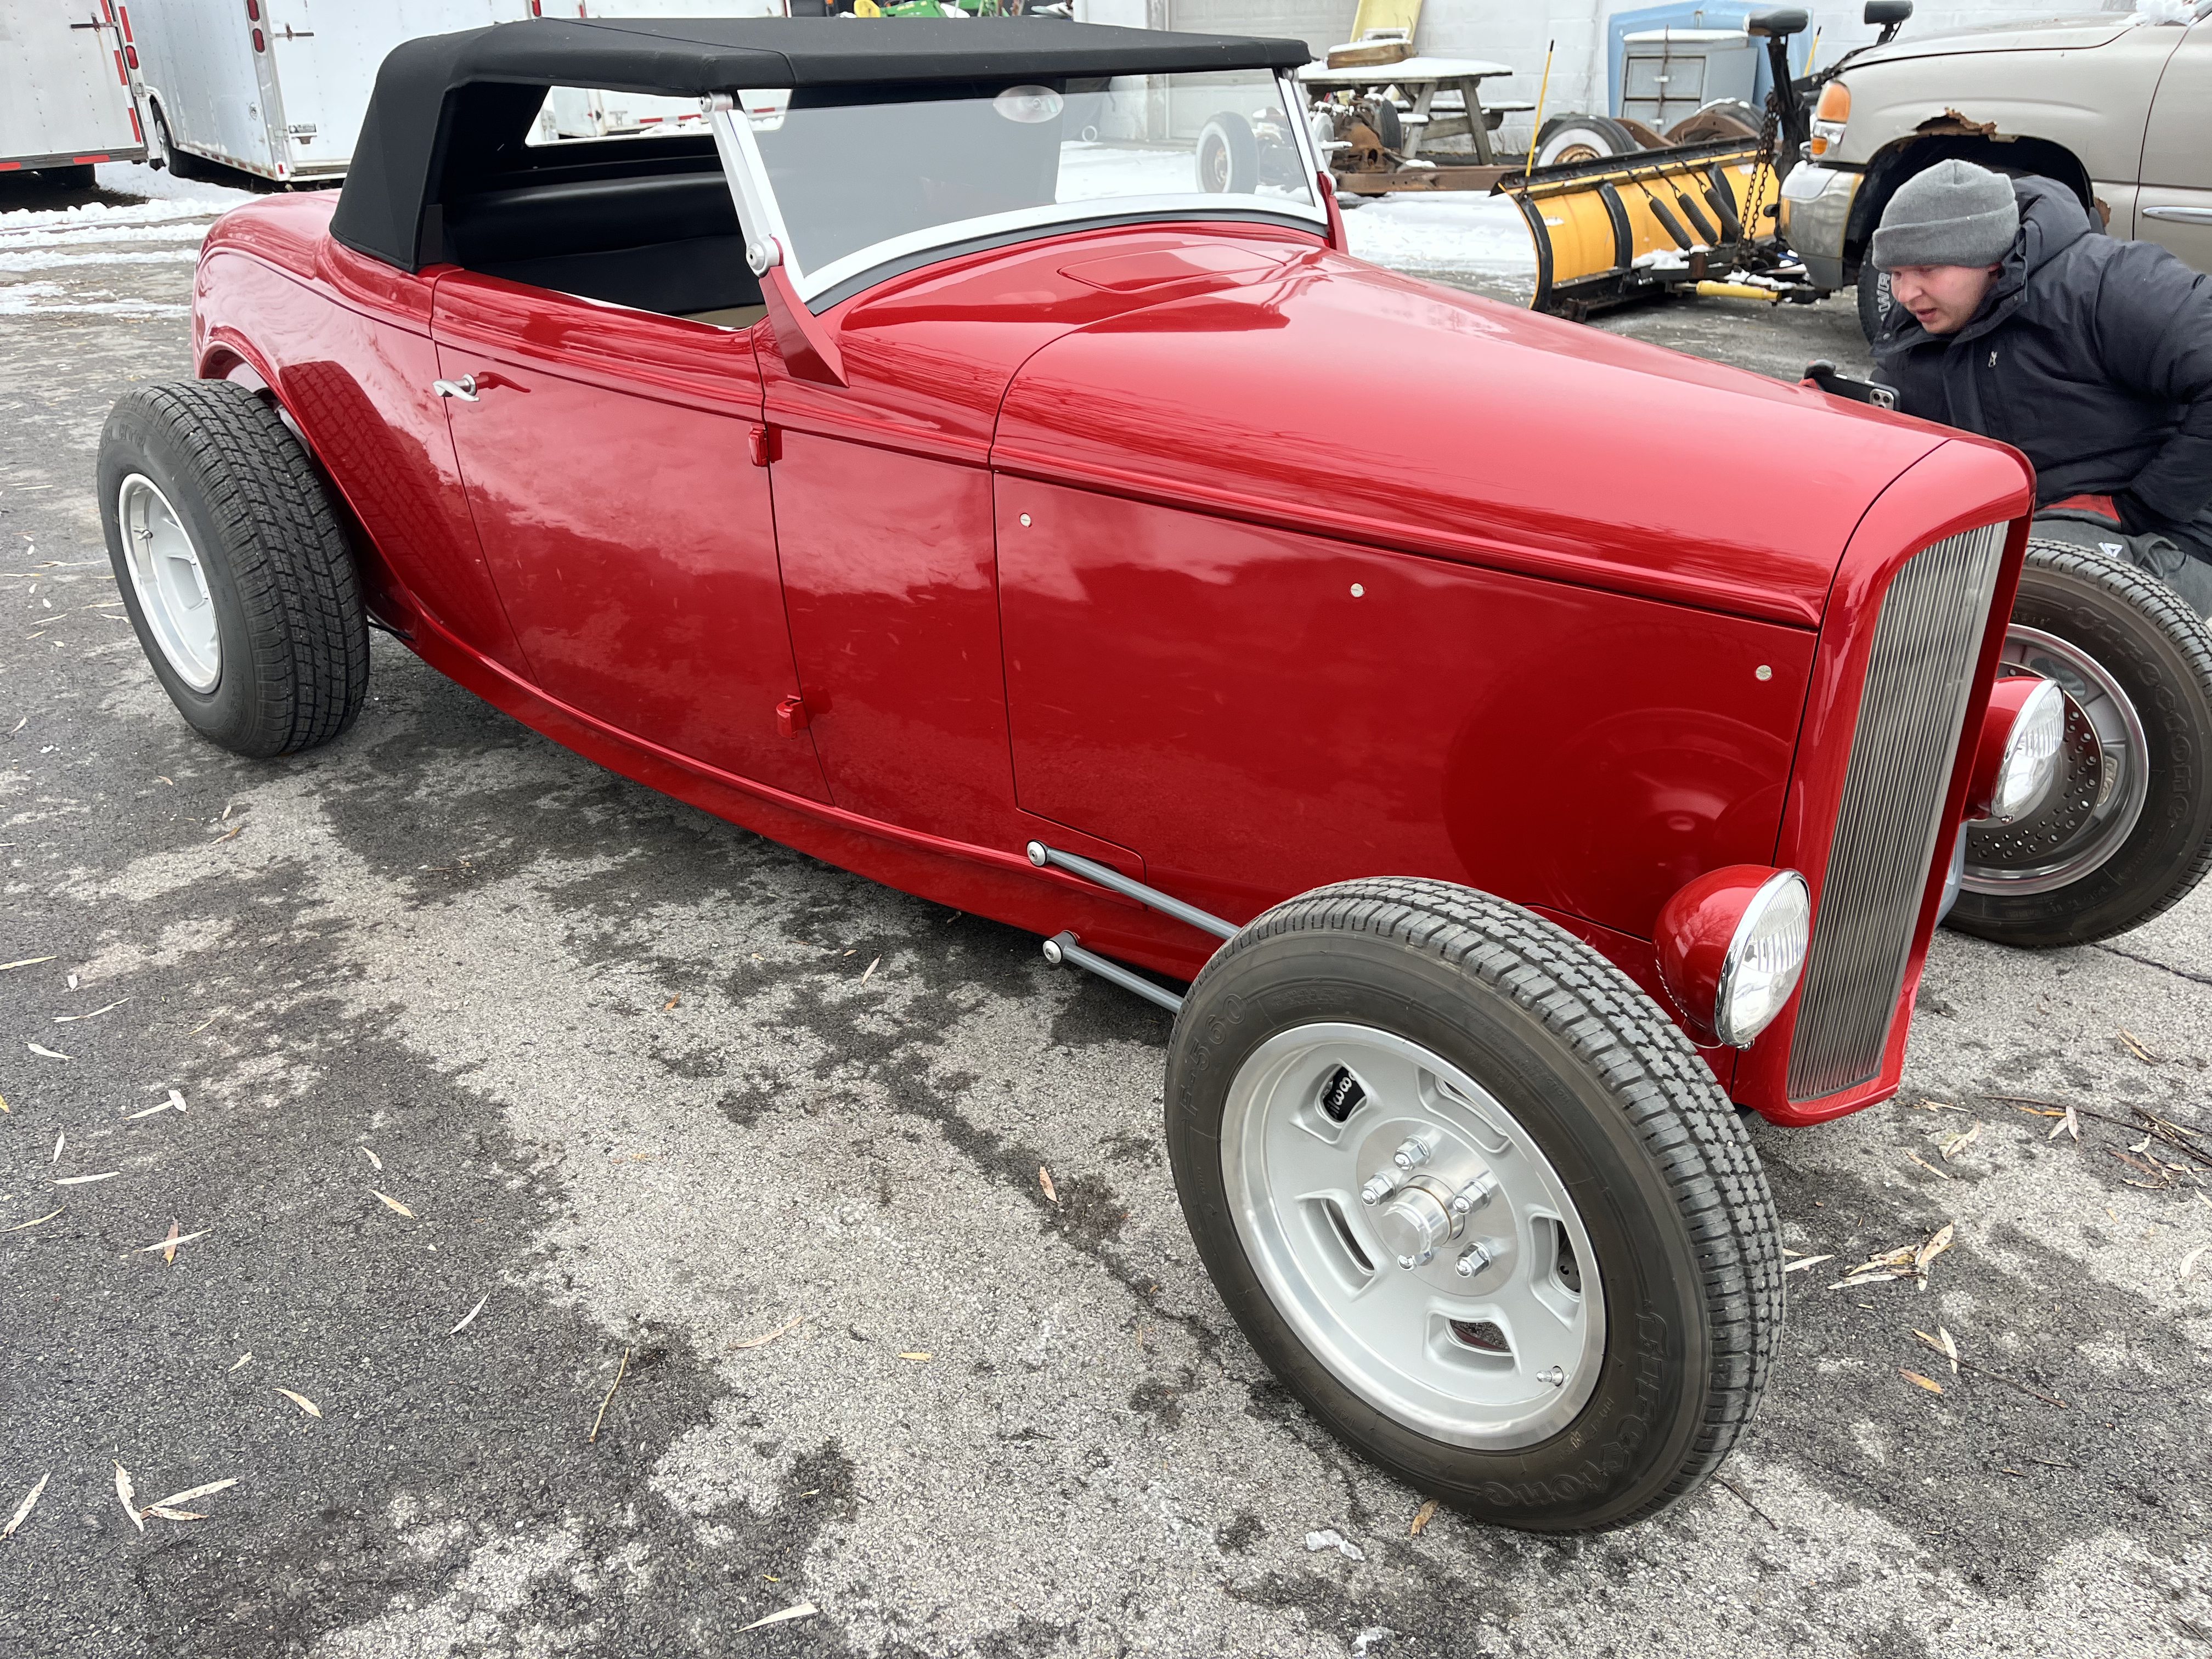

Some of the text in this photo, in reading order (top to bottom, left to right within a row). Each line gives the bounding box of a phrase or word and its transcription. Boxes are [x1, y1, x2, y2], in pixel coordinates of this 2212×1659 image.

[1180, 994, 1245, 1118] F-560
[1465, 1043, 1538, 1116] RADIAL
[1482, 1312, 1668, 1506] Firestone
